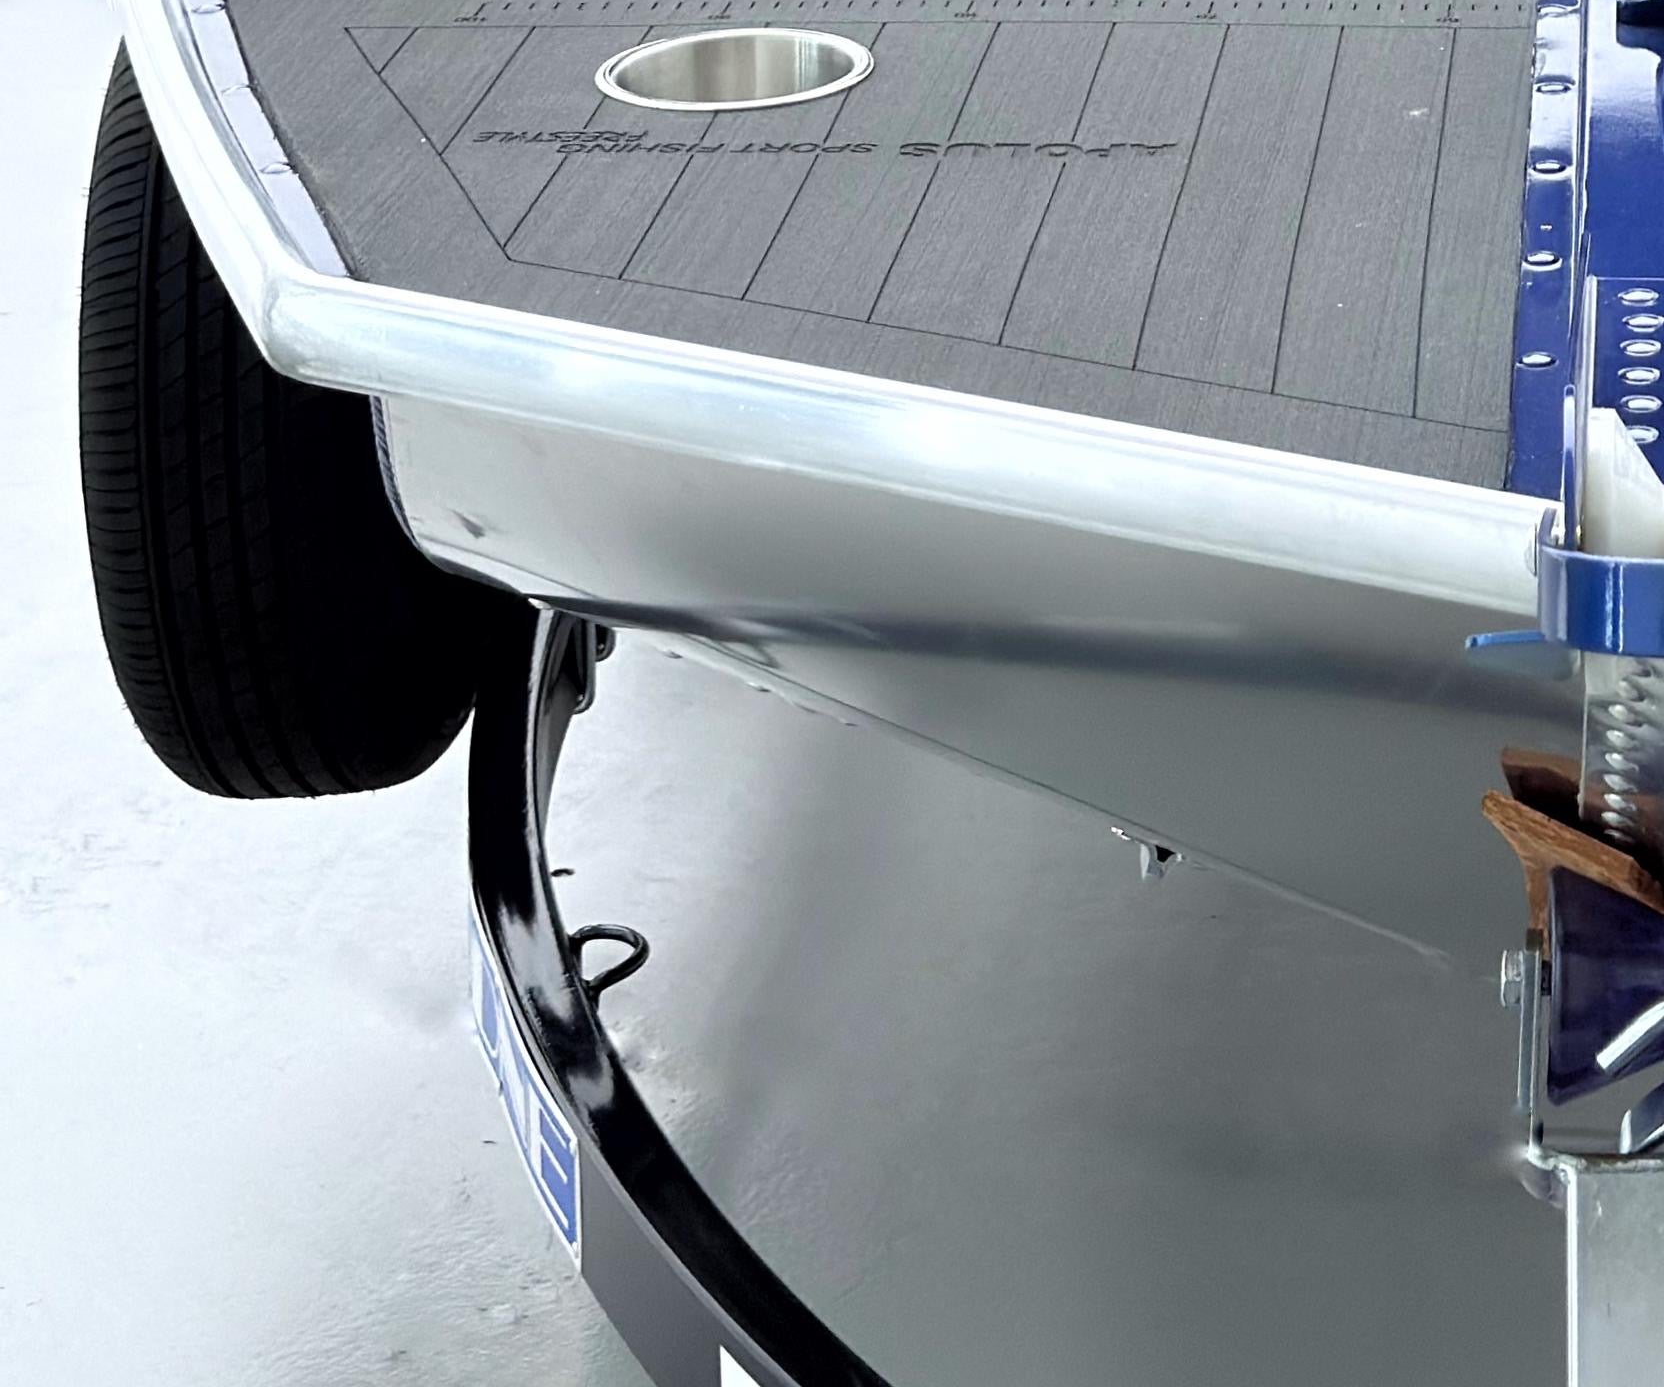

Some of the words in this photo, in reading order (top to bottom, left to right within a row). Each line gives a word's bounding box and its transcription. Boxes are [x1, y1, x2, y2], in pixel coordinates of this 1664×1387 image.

[472, 130, 649, 143] FREESTYLE
[555, 142, 726, 154] FISHING
[729, 142, 879, 154] SPORT
